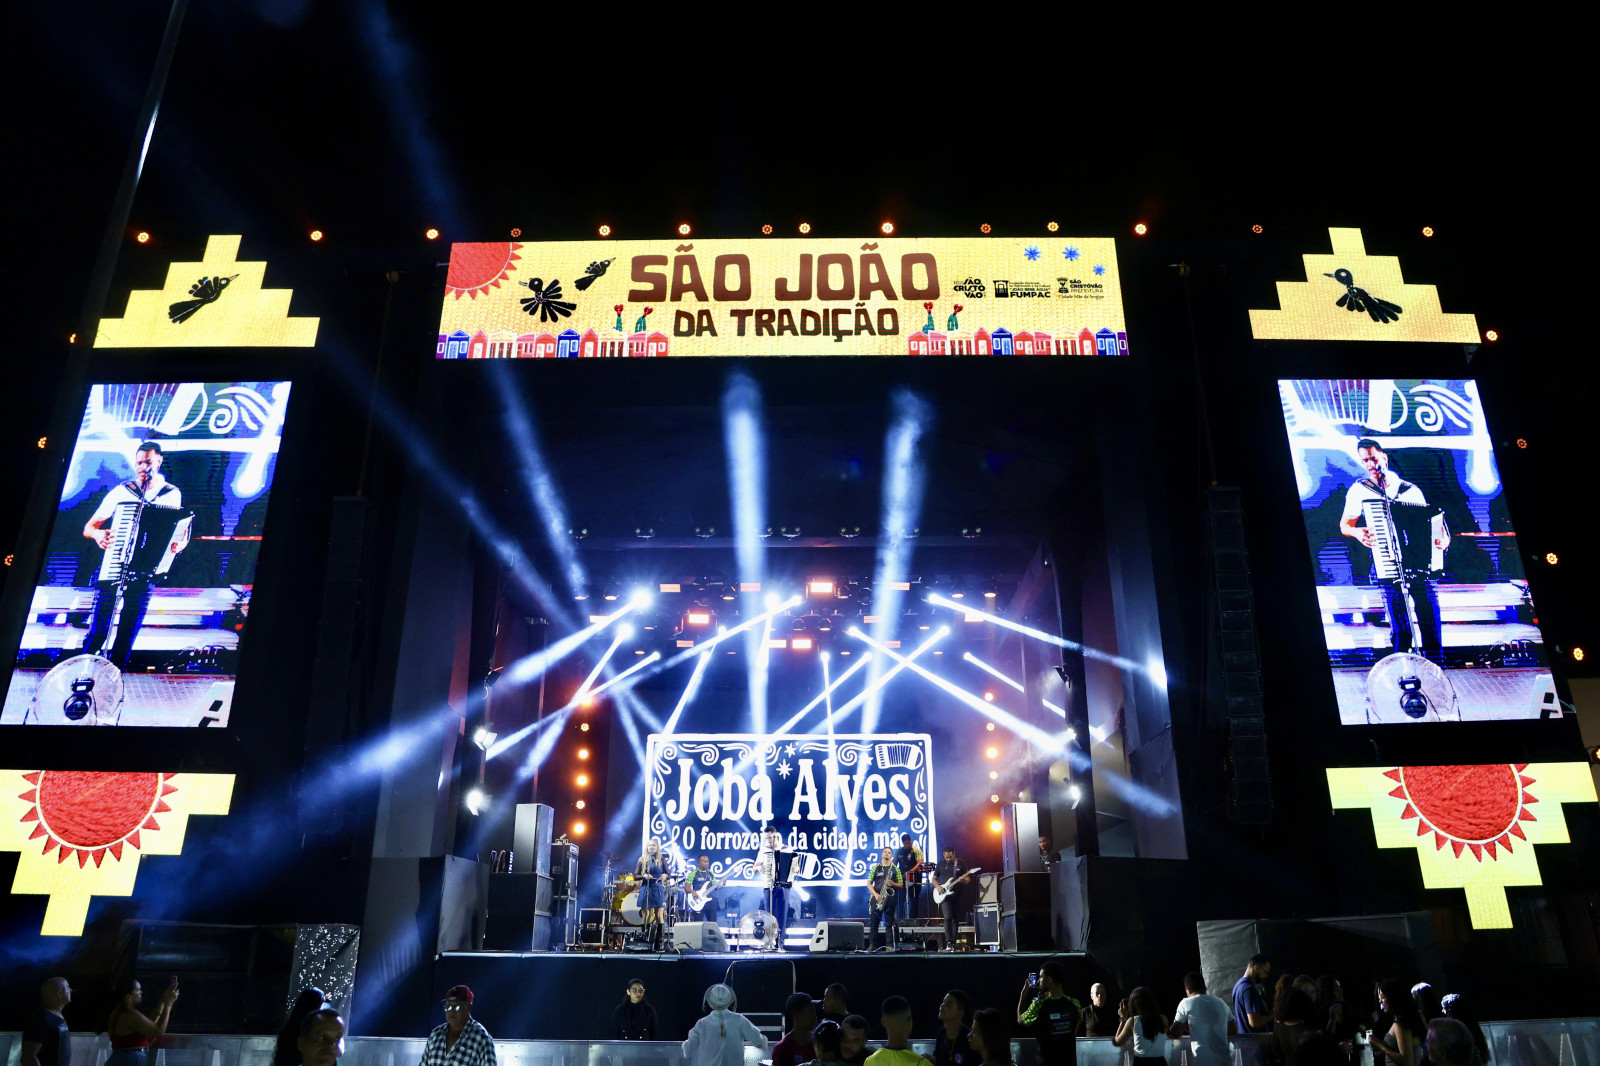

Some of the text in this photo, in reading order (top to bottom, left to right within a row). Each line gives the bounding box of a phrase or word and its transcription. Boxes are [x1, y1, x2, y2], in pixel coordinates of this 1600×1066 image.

[627, 242, 940, 302] SÃO JOÃO
[672, 302, 899, 342] DA TRADIÇÃO
[665, 757, 912, 821] Joba Alves
[683, 826, 696, 848] O
[787, 826, 809, 850] da
[813, 826, 868, 850] cidade
